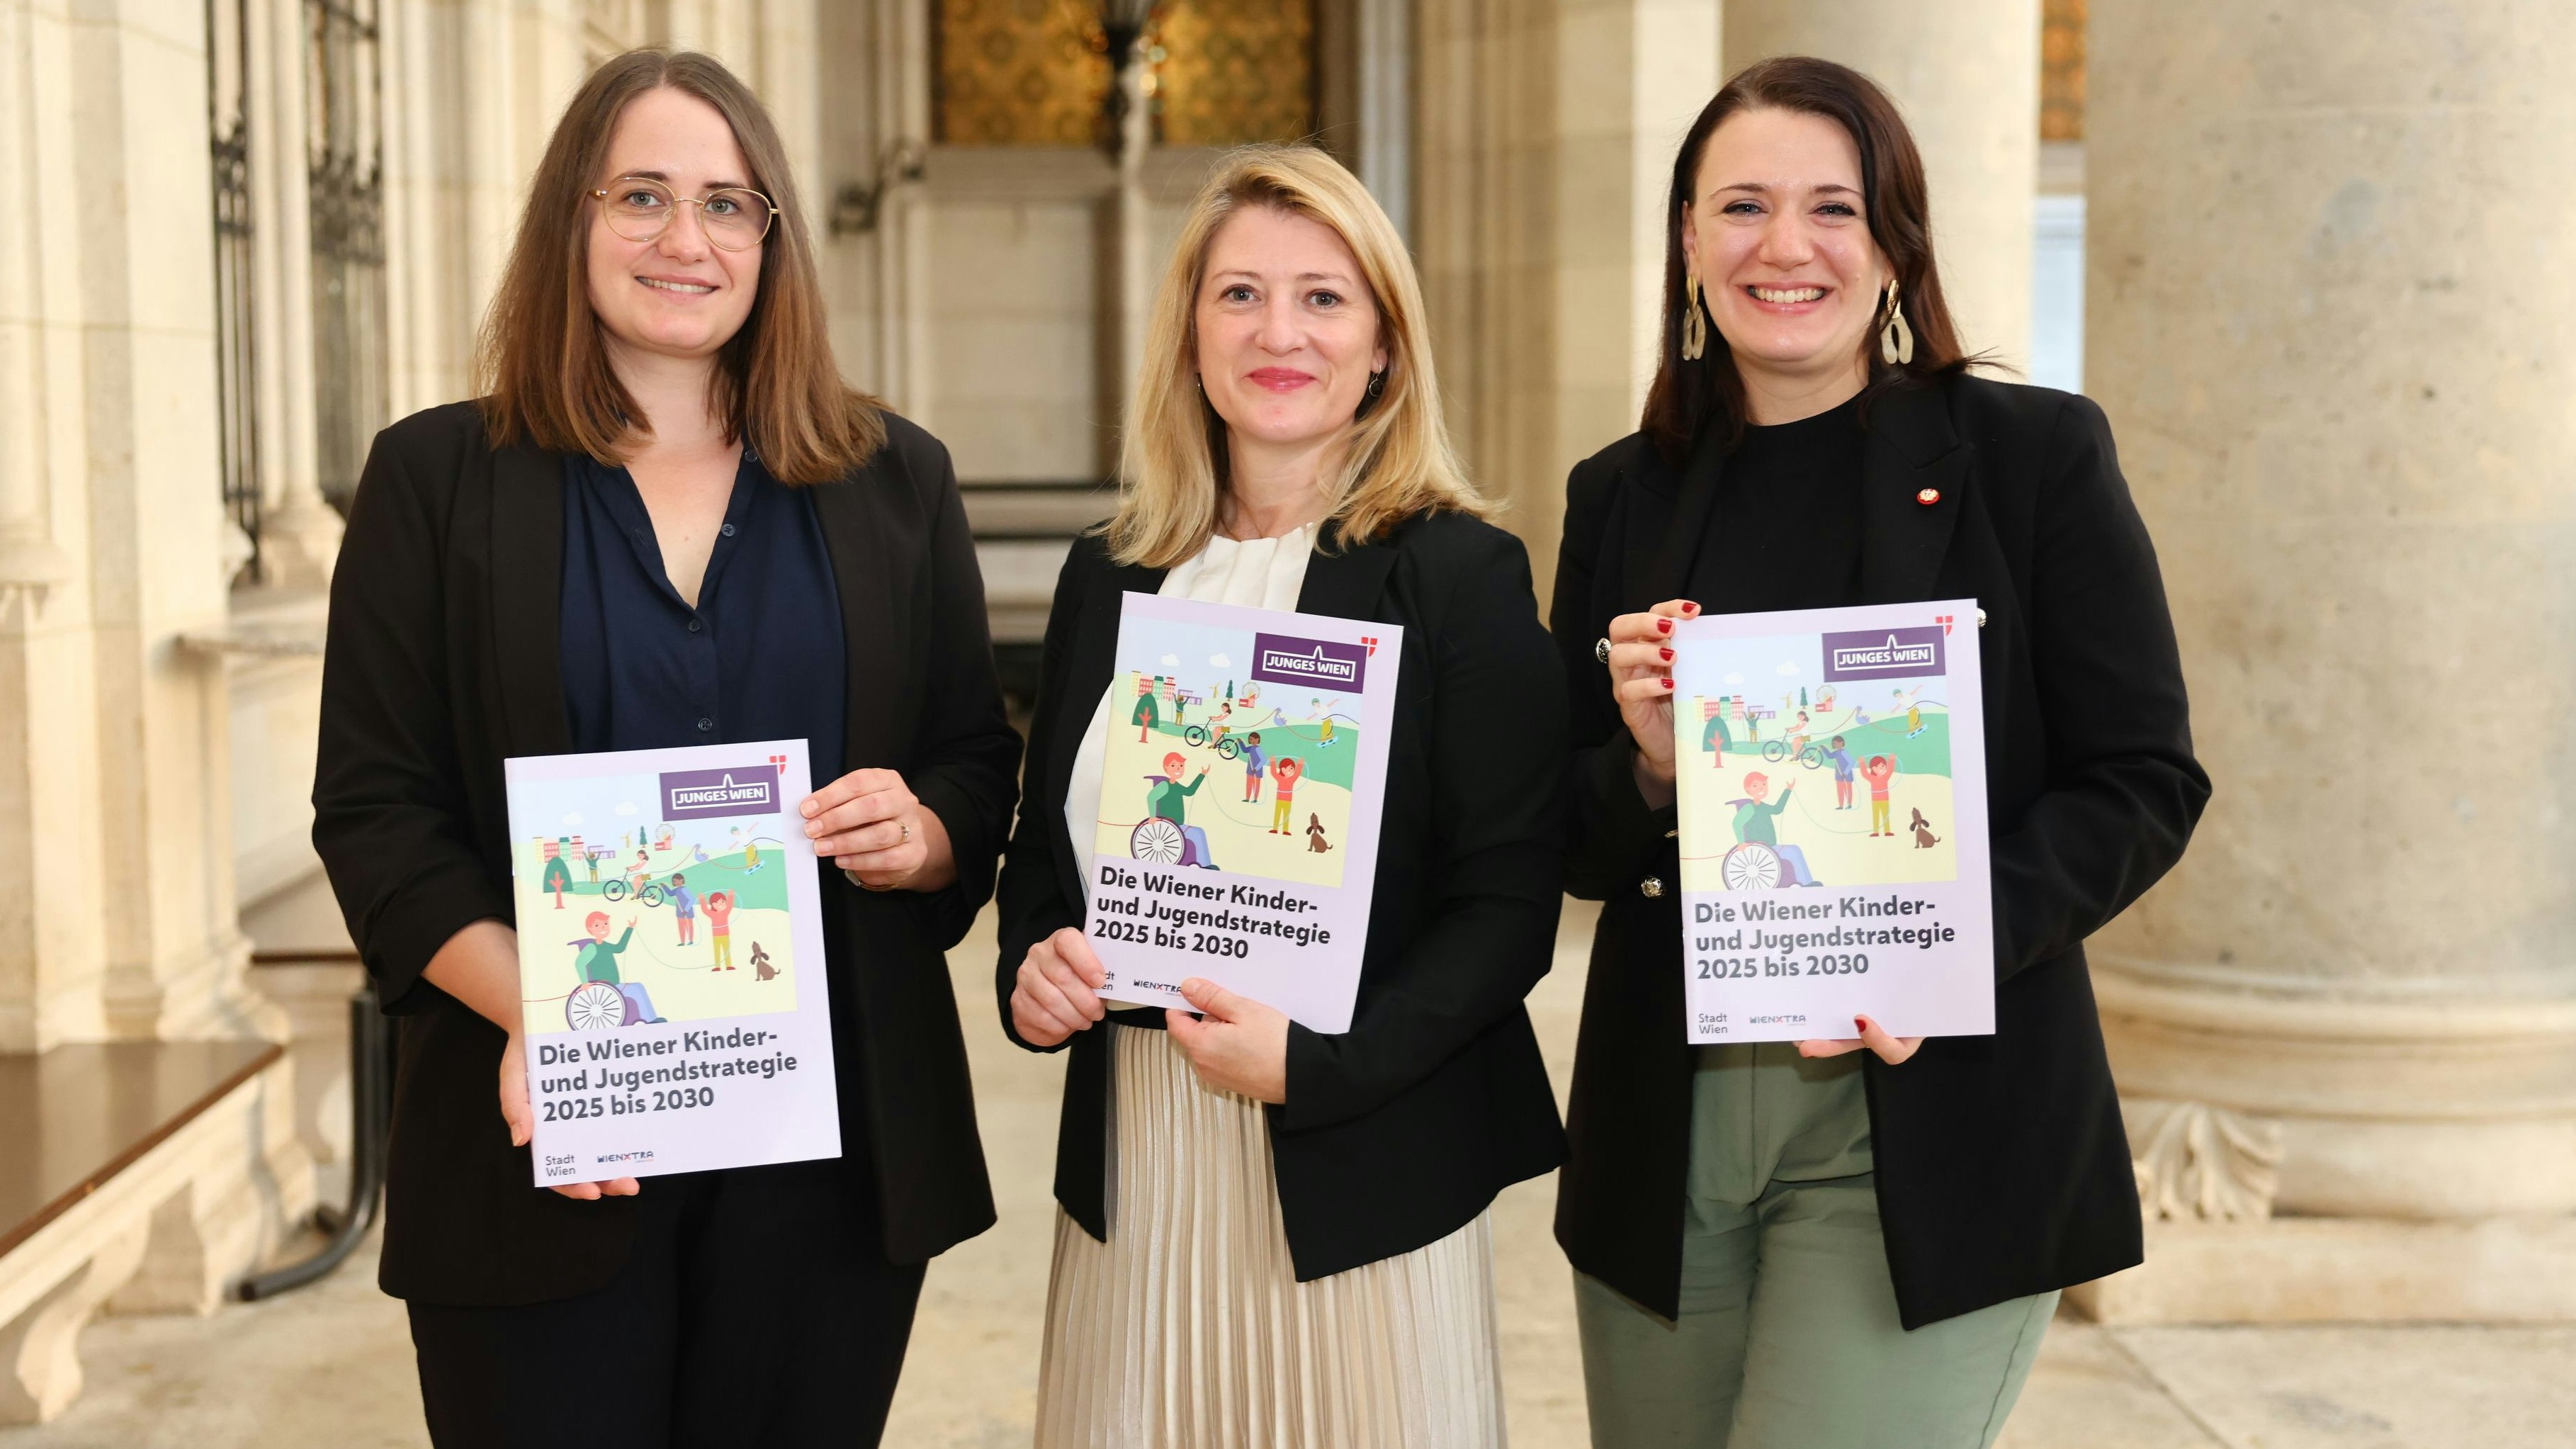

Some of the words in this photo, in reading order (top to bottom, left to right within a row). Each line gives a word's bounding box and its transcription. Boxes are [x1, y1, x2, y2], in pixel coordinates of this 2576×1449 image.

[1267, 656, 1316, 671] JUNGES
[1317, 662, 1350, 675] WIEN
[1839, 651, 1891, 665] JUNGES
[1892, 650, 1928, 662] WIEN
[677, 791, 727, 804] JUNGES
[730, 787, 764, 800] WIEN
[1100, 866, 1137, 889] Die
[1143, 871, 1226, 902] Wiener
[1231, 884, 1318, 915] Kinder-
[1097, 895, 1140, 917] und
[1145, 901, 1331, 946] Jugendstrategie
[1695, 903, 1736, 924] Die
[1741, 900, 1832, 920] Wiener
[1839, 896, 1936, 917] Kinder-
[1093, 919, 1149, 945] 2025
[1154, 926, 1187, 950] bis
[1192, 934, 1249, 959] 2030
[1696, 929, 1742, 952] und
[1749, 922, 1955, 953] Jugendstrategie
[1696, 957, 1758, 980] 2025
[1764, 956, 1800, 977] bis
[1805, 953, 1870, 976] 2030
[1699, 1012, 1727, 1024] Stadt
[1699, 1024, 1728, 1035] Wien
[539, 1044, 580, 1066] Die
[587, 1036, 677, 1061] Wiener
[684, 1028, 779, 1053] Kinder-
[541, 1071, 588, 1094] und
[594, 1052, 797, 1092] Jugendstrategie
[543, 1098, 604, 1122] 2025
[611, 1093, 646, 1115] bis
[652, 1086, 715, 1111] 2030
[545, 1154, 575, 1166] Stadt
[546, 1165, 576, 1177] Wien
